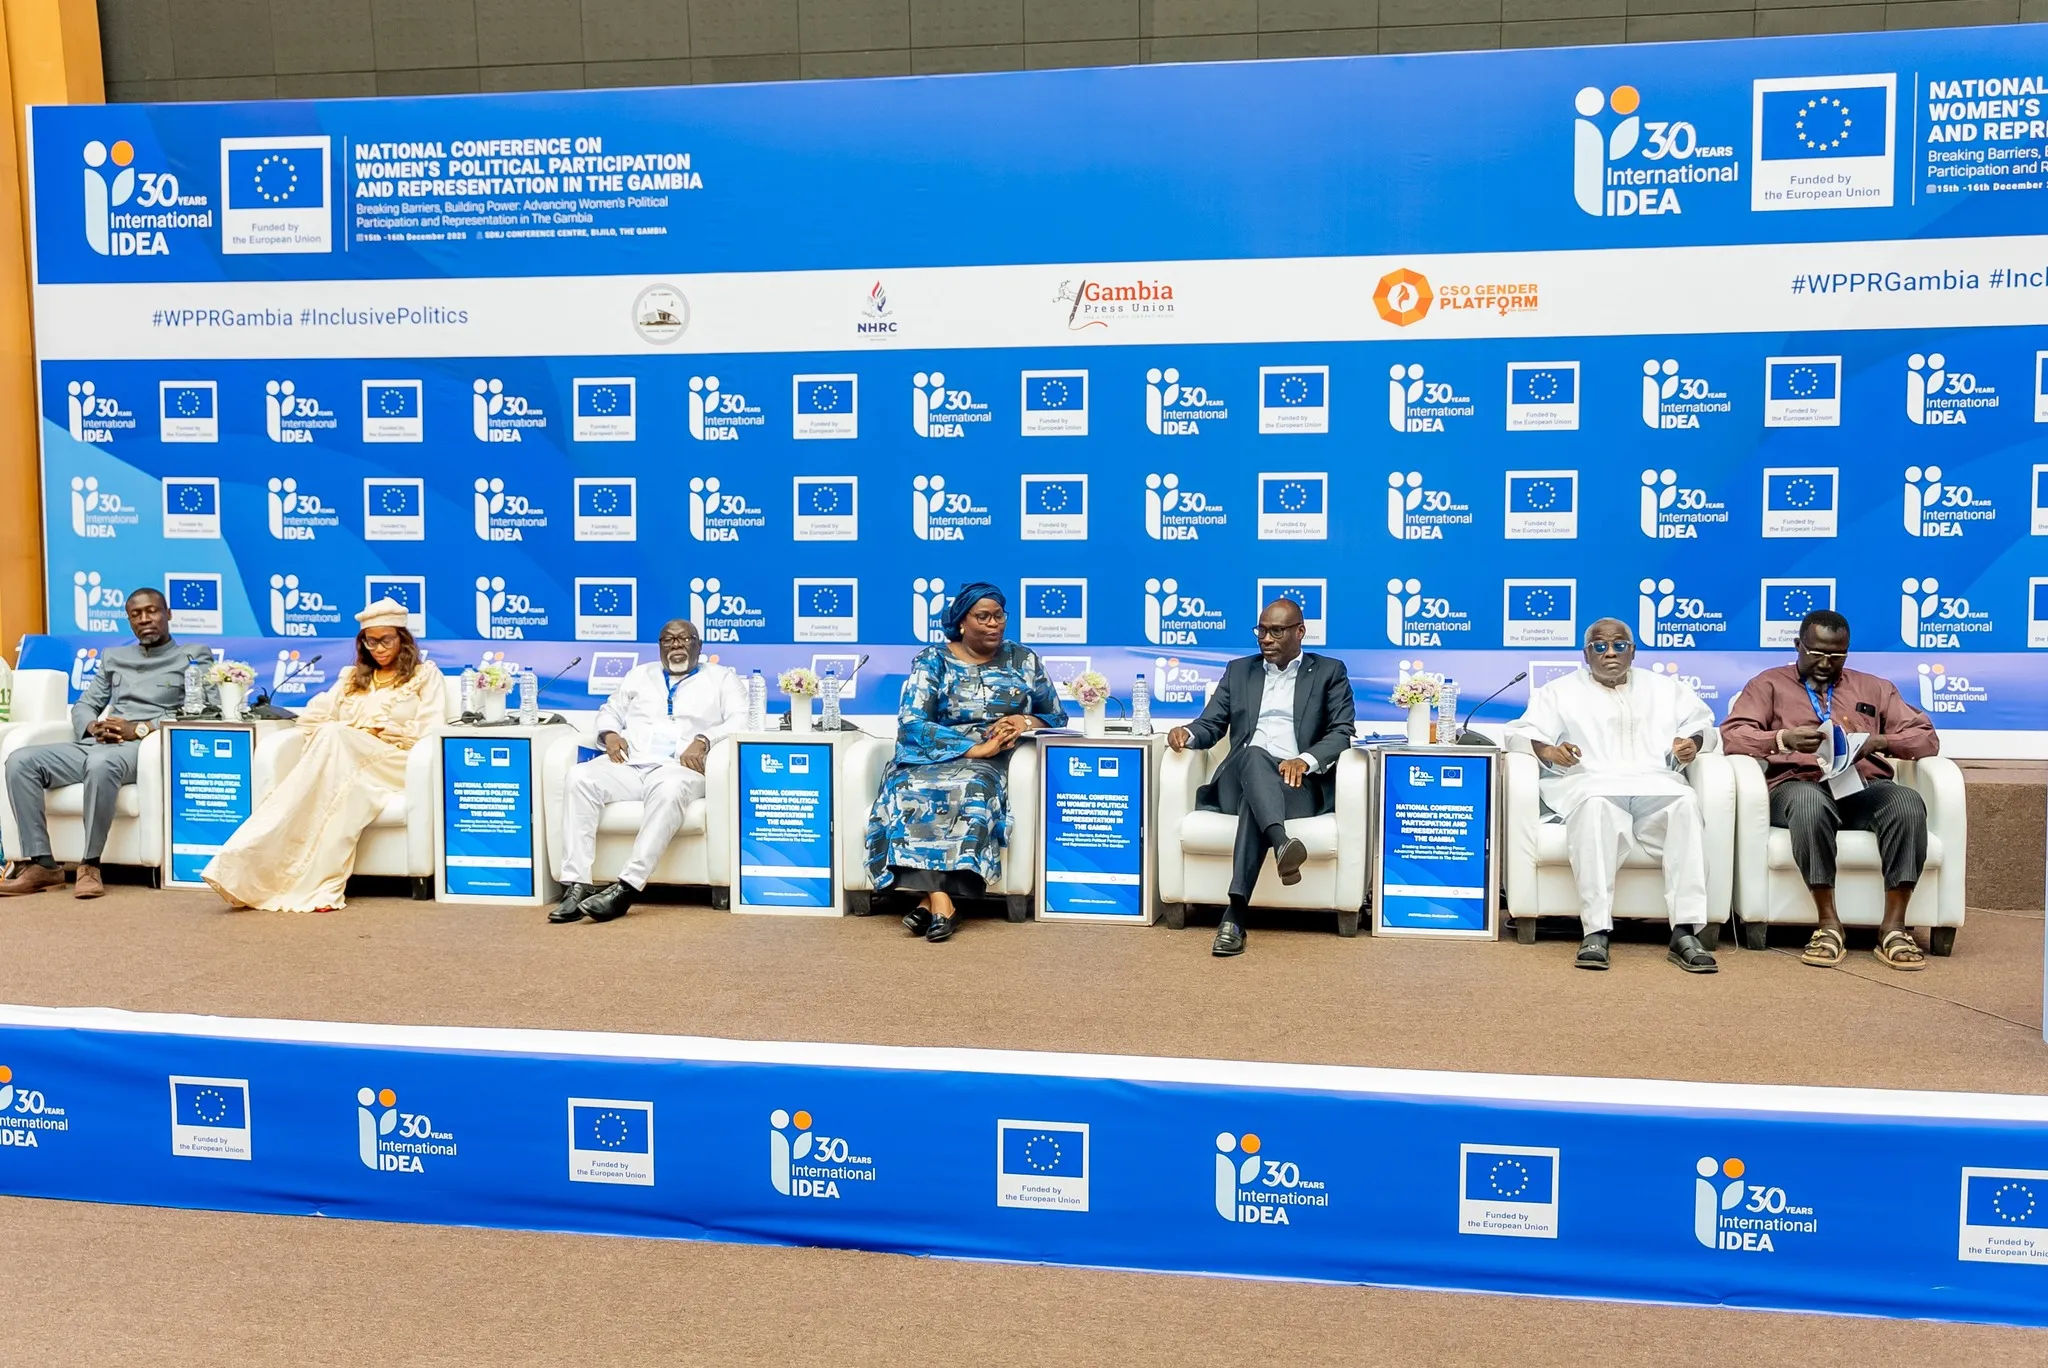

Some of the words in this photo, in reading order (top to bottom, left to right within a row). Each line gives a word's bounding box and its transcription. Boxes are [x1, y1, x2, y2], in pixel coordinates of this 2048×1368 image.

[1930, 76, 2048, 99] NATIONAL
[1929, 98, 2040, 121] WOMEN'S
[1641, 121, 1696, 160] 30
[1695, 147, 1733, 158] YEARS
[1928, 123, 1977, 143] AND
[356, 142, 447, 160] NATIONAL
[451, 138, 571, 157] CONFERENCE
[575, 137, 602, 154] ON
[1928, 149, 1984, 163] Breaking
[1988, 146, 2041, 160] Barriers,
[356, 161, 440, 179] WOMEN'S
[449, 158, 544, 176] POLITICAL
[549, 153, 690, 174] PARTICIPATION
[1607, 162, 1738, 185] International
[1928, 163, 2009, 178] Participation
[2012, 161, 2037, 174] and
[356, 181, 393, 198] AND
[398, 177, 558, 196] REPRESENTATION
[563, 176, 582, 192] IN
[586, 175, 623, 191] THE
[627, 172, 703, 190] GAMBIA
[1790, 174, 1833, 185] Funded
[1838, 173, 1851, 185] by
[1938, 184, 1959, 192] 15th
[1963, 183, 1989, 191] -16th
[1993, 182, 2042, 190] December
[137, 173, 179, 207] 30
[178, 196, 207, 206] YEARS
[1765, 189, 1783, 200] the
[1787, 188, 1842, 200] European
[1846, 187, 1880, 197] Union
[356, 203, 399, 216] Breaking
[402, 202, 442, 214] Barriers,
[445, 201, 484, 214] Building
[487, 200, 520, 211] Power:
[523, 199, 576, 211] Advancing
[579, 198, 625, 209] Women's
[628, 196, 668, 207] Political
[1607, 188, 1681, 216] IDEA
[111, 210, 212, 229] International
[252, 223, 285, 232] Funded
[288, 223, 298, 233] by
[356, 216, 418, 229] Participation
[421, 216, 440, 226] and
[442, 214, 518, 227] Representation
[520, 214, 529, 224] in
[532, 213, 550, 223] The
[553, 212, 593, 223] Gambia
[112, 232, 169, 256] IDEA
[233, 236, 246, 244] the
[249, 236, 292, 246] European
[295, 235, 321, 243] Union
[1085, 280, 1173, 301] Gambia
[1440, 286, 1470, 295] CSO
[1475, 284, 1538, 295] GENDER
[1791, 270, 1979, 294] #WPPRGambia
[1084, 304, 1124, 313] Press
[1132, 303, 1174, 312] Union
[1440, 296, 1538, 310] PLATFORM
[152, 308, 292, 327] #WPPRGambia
[300, 307, 468, 326] #InclusivePolitics
[857, 322, 897, 333] NHRC
[295, 398, 318, 417] 30
[945, 390, 971, 410] 30
[282, 418, 337, 429] International
[930, 412, 991, 423] International
[282, 430, 313, 443] IDEA
[930, 423, 964, 438] IDEA
[1423, 491, 1450, 510] 30
[1405, 513, 1472, 525] International
[1405, 525, 1443, 539] IDEA
[1939, 598, 1969, 619] 30
[1920, 621, 1992, 632] International
[1920, 634, 1960, 648] IDEA
[1947, 677, 1969, 692] 30
[1934, 692, 1987, 702] International
[1934, 702, 1965, 713] IDEA
[14, 1089, 44, 1114] 30
[44, 1107, 64, 1116] YEARS
[0, 1116, 68, 1131] nternational
[399, 1113, 432, 1139] 30
[430, 1132, 453, 1140] YEARS
[192, 1144, 223, 1153] European
[193, 1136, 217, 1144] Funded
[220, 1136, 228, 1146] by
[379, 1139, 457, 1155] International
[814, 1137, 848, 1164] 30
[848, 1156, 872, 1164] YEARS
[379, 1154, 424, 1173] IDEA
[592, 1161, 618, 1169] Funded
[621, 1162, 629, 1171] by
[590, 1170, 624, 1179] European
[792, 1164, 875, 1181] International
[1261, 1161, 1299, 1188] 30
[1299, 1181, 1324, 1189] YEARS
[793, 1180, 839, 1198] IDEA
[1022, 1186, 1050, 1194] Funded
[1053, 1186, 1061, 1195] by
[1238, 1189, 1328, 1206] International
[1006, 1194, 1017, 1202] the
[1019, 1194, 1055, 1204] European
[1058, 1196, 1080, 1205] Union
[1745, 1185, 1786, 1214] 30
[1785, 1207, 1813, 1215] YEARS
[1239, 1206, 1289, 1225] IDEA
[1486, 1211, 1516, 1221] Funded
[1519, 1212, 1528, 1222] by
[1720, 1215, 1817, 1232] International
[1468, 1220, 1480, 1228] the
[1483, 1221, 1521, 1231] European
[1524, 1223, 1548, 1231] Union
[1720, 1232, 1774, 1251] IDEA
[1989, 1238, 2021, 1246] Funded
[2024, 1239, 2034, 1247] by
[1985, 1248, 2027, 1257] European
